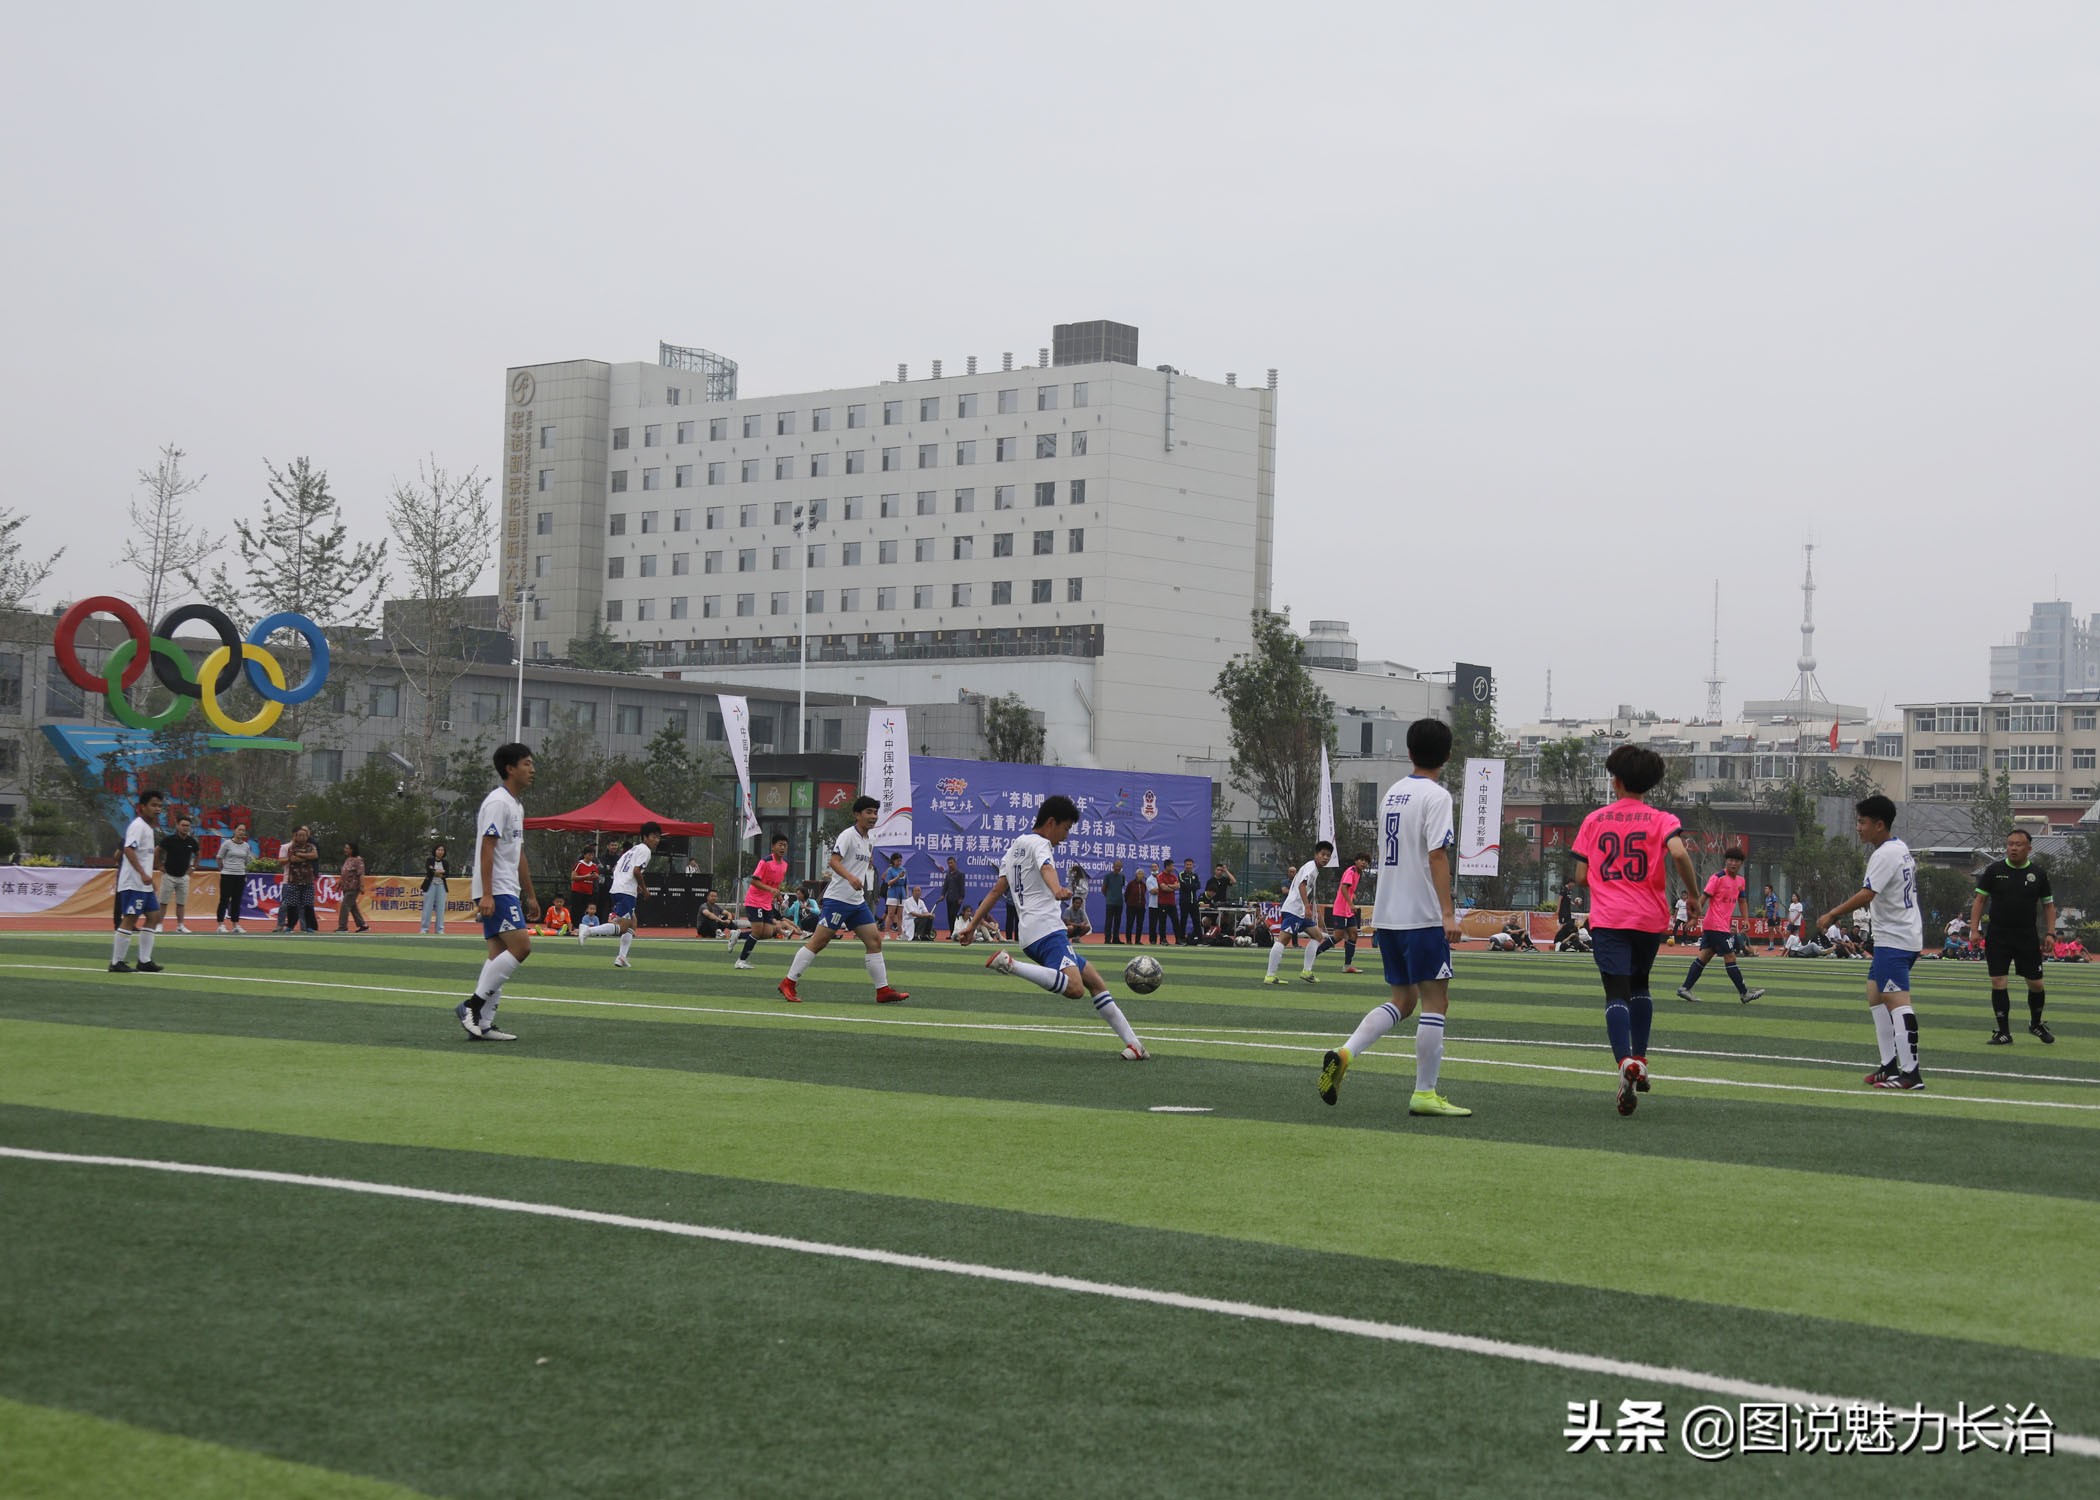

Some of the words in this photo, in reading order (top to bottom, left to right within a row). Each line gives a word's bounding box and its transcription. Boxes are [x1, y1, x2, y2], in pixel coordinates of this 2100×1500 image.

[882, 740, 894, 813] 中国体育彩票
[1385, 813, 1400, 866] 8
[1476, 784, 1488, 846] 中国体育彩票
[1598, 831, 1648, 882] 25
[1, 882, 59, 897] 体育彩票
[509, 906, 521, 922] 5
[831, 911, 842, 925] 10
